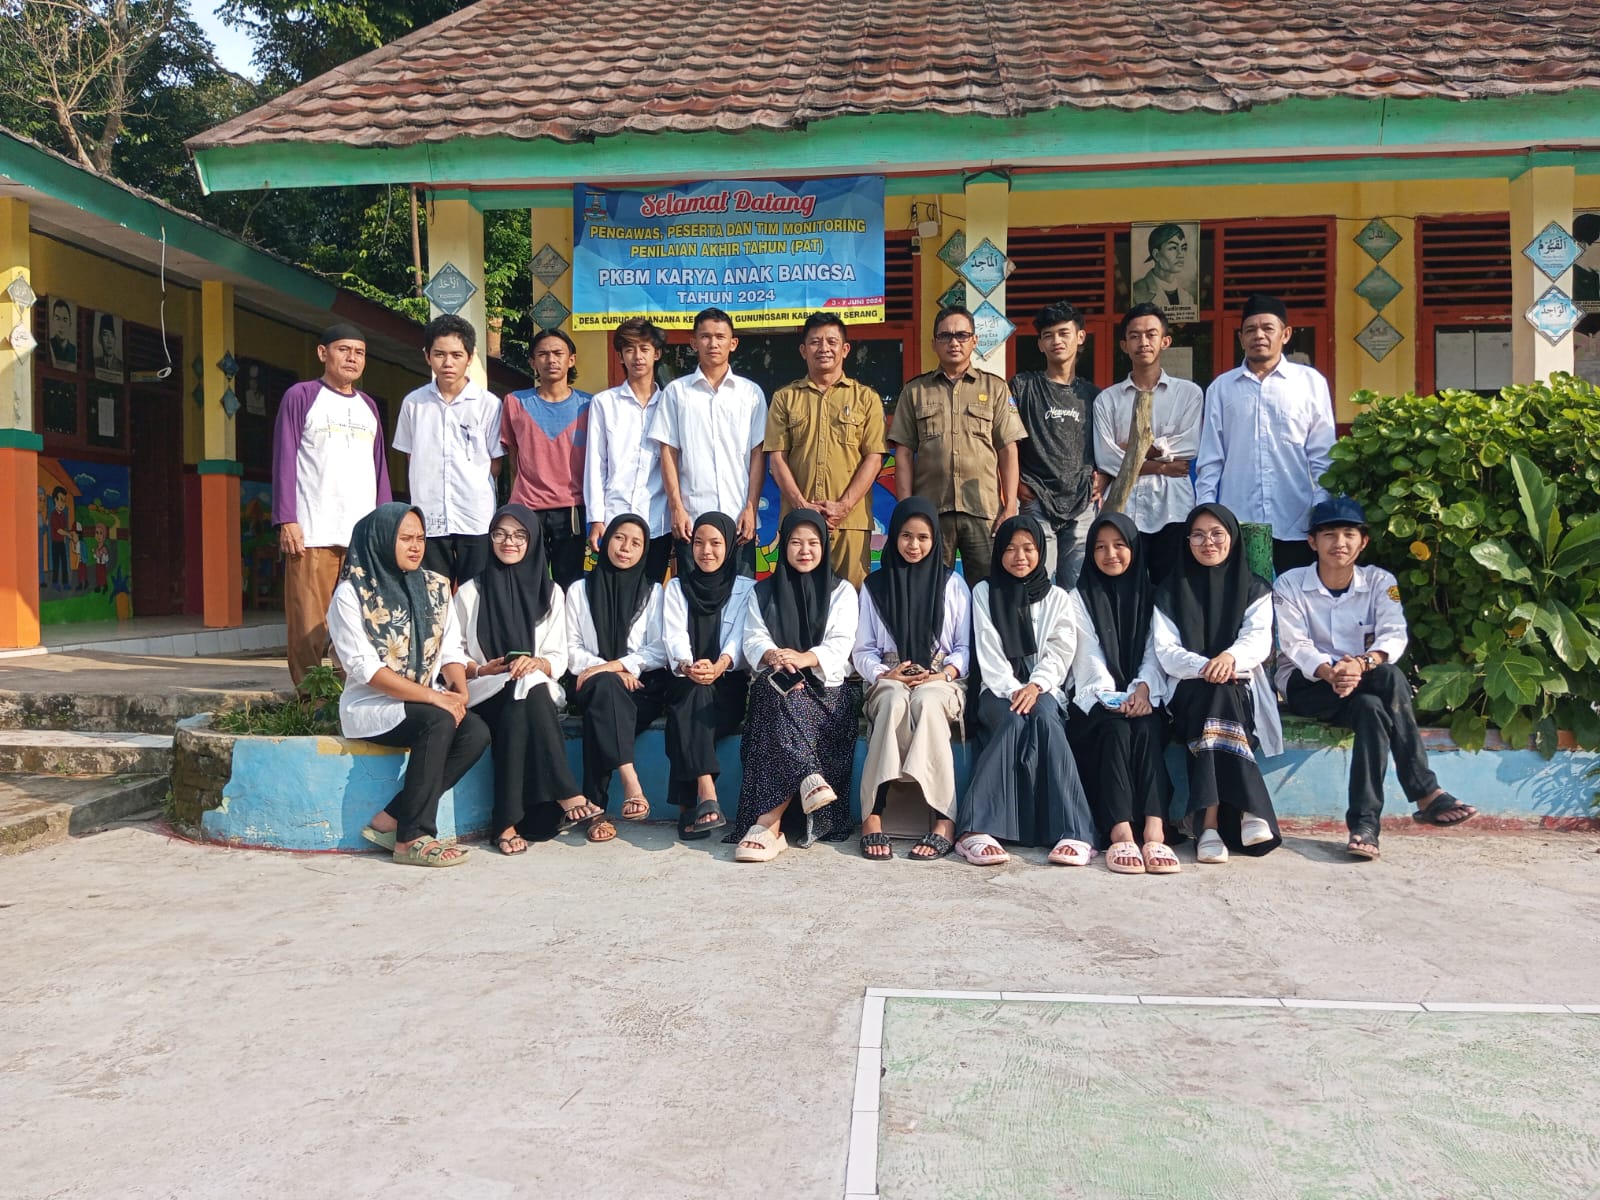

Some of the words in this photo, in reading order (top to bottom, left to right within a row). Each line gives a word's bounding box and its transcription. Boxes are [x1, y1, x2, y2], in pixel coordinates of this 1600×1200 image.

[640, 191, 728, 218] Selamat
[733, 190, 816, 218] Datang
[590, 225, 664, 240] PENGAWAS,
[667, 223, 723, 238] PESERTA
[726, 222, 752, 236] DAN
[755, 222, 779, 236] TIM
[783, 218, 866, 235] MONITORING
[630, 243, 698, 258] PENILAIAN
[701, 243, 740, 257] AKHIR
[743, 240, 787, 254] TAHUN
[790, 239, 824, 256] (PAT)
[599, 268, 651, 286] PKBM
[655, 267, 718, 285] KARYA
[722, 265, 773, 284] ANAK
[778, 264, 856, 282] BANGSA
[677, 291, 733, 304] TAHUN
[738, 289, 776, 303] 2024
[865, 296, 883, 304] 2024
[579, 317, 600, 325] DESA
[735, 312, 790, 323] GUNUNGSARI
[843, 310, 878, 319] SERANG
